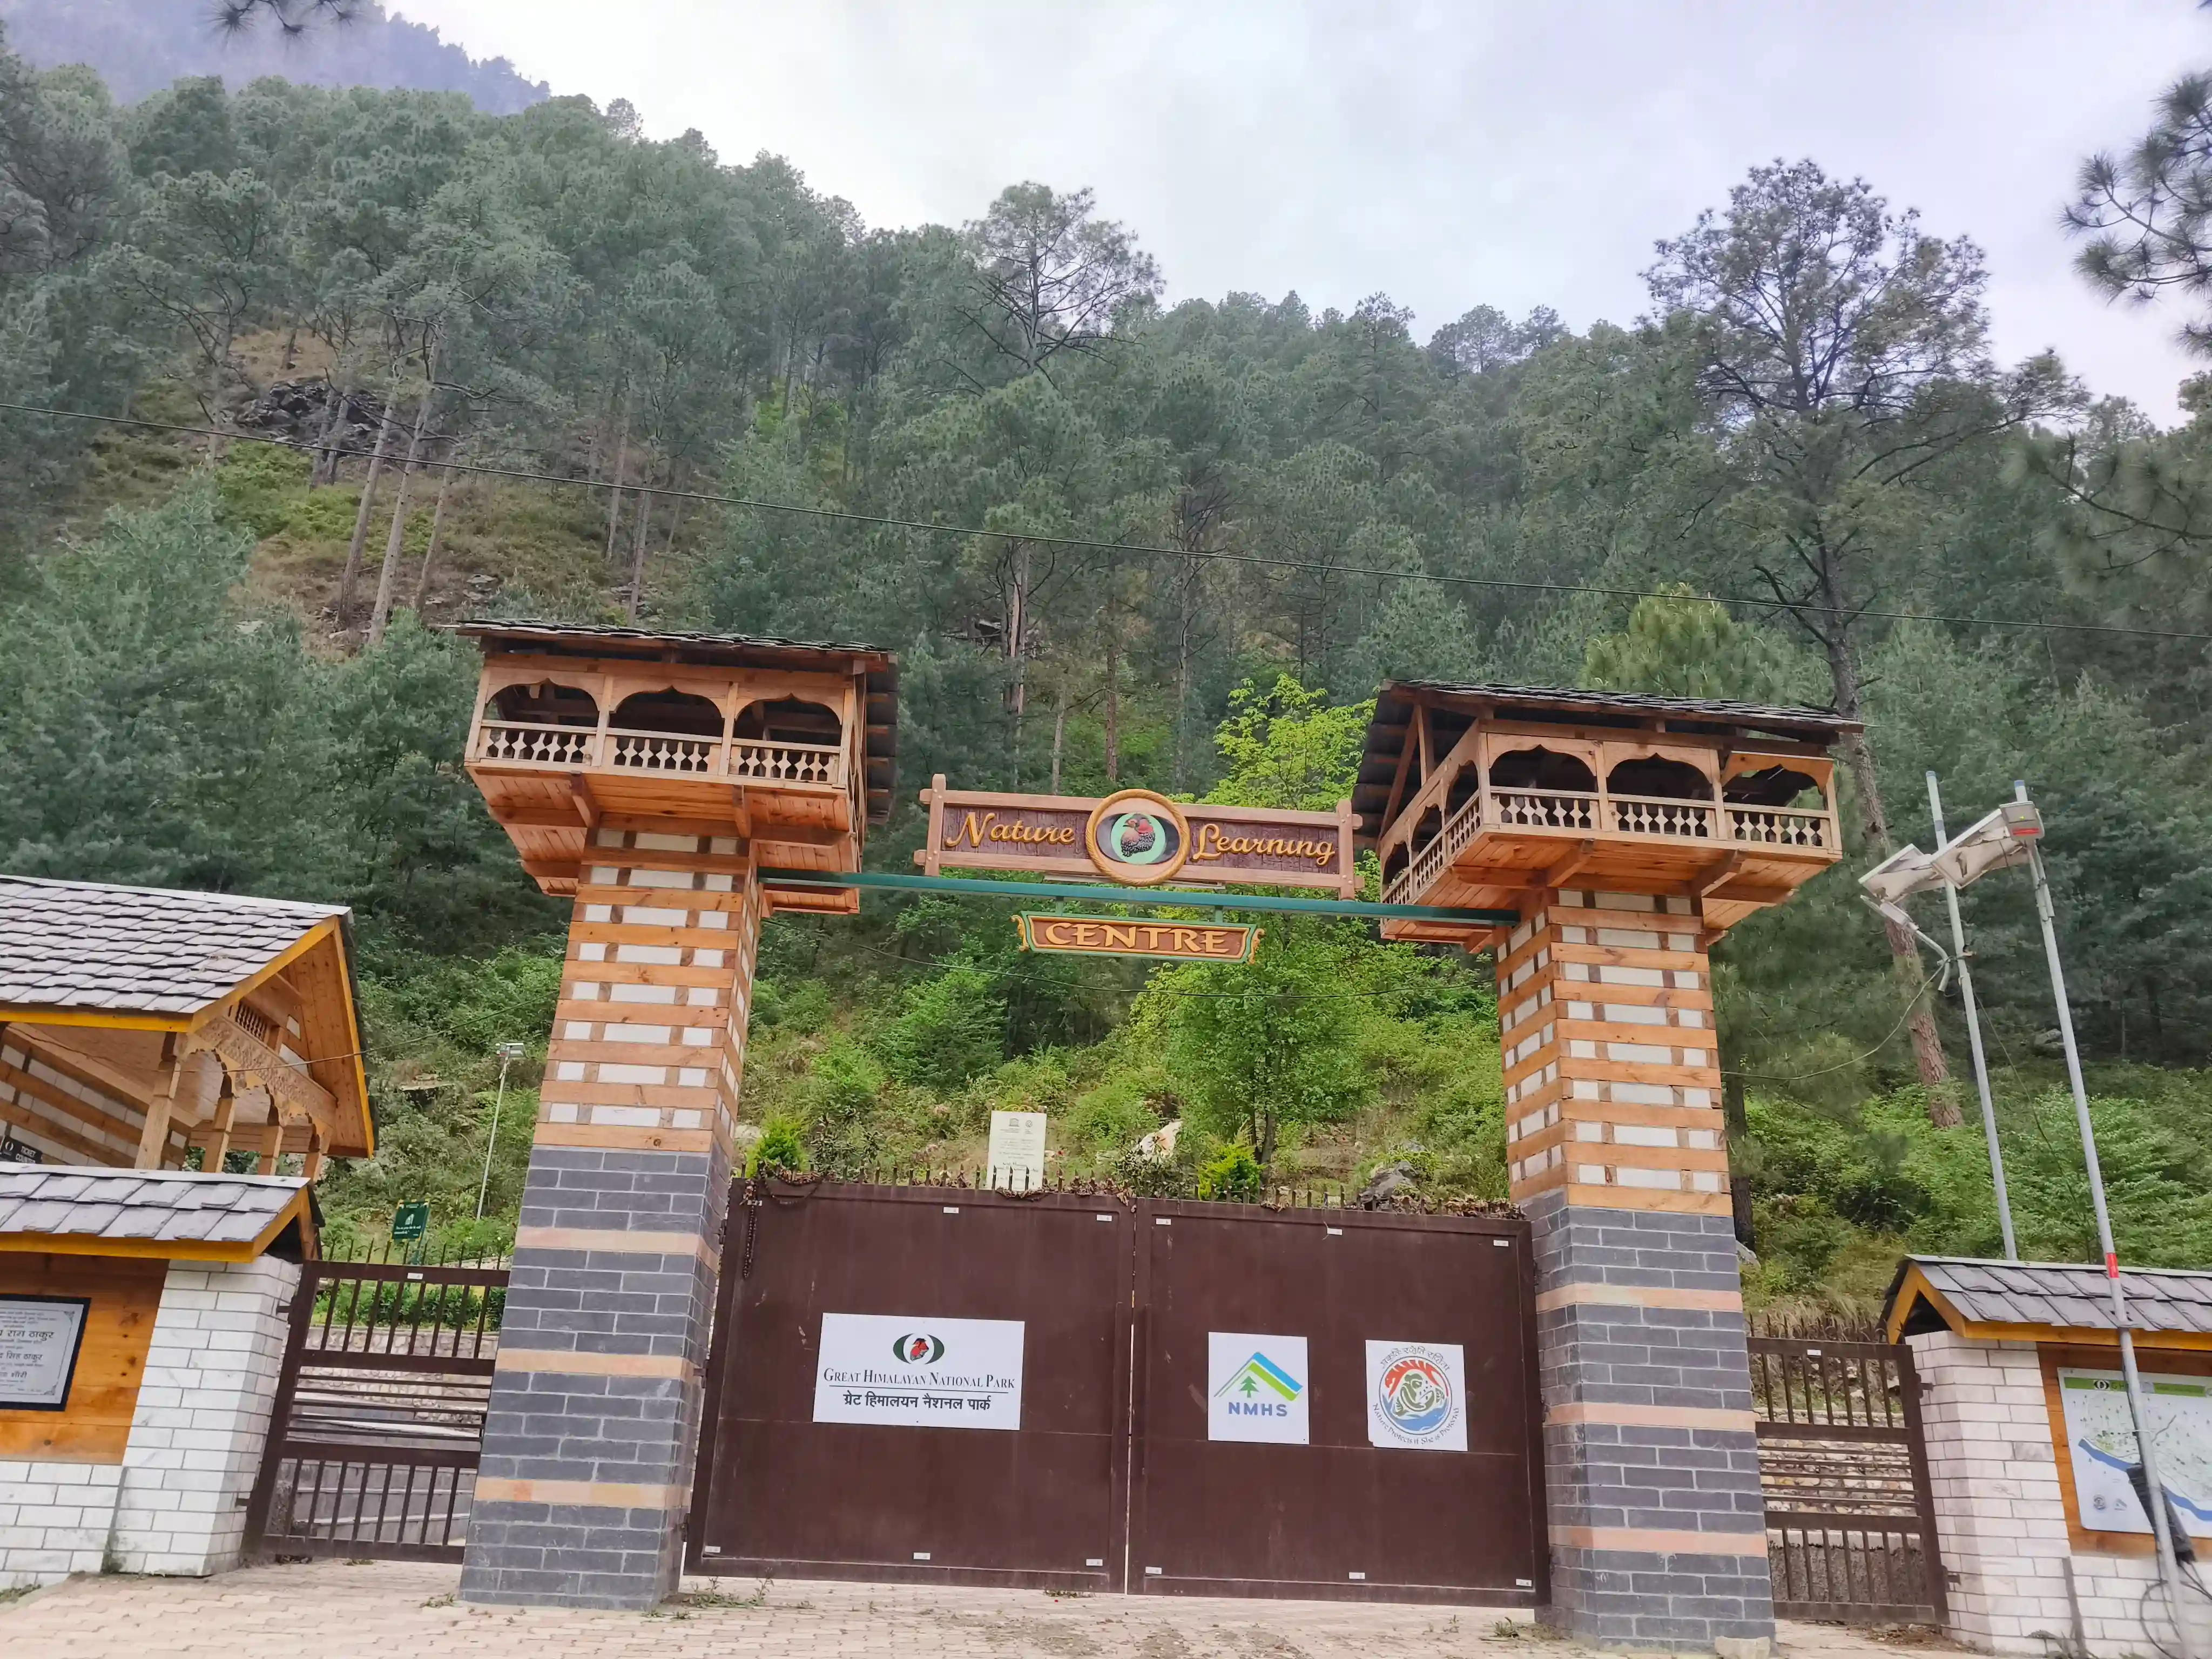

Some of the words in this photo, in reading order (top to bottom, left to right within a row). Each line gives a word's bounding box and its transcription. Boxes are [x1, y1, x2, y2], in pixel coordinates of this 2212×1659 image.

[945, 812, 1075, 847] Nature
[1190, 823, 1335, 867] Learning
[1046, 922, 1229, 954] CENTRE
[21, 1146, 36, 1157] TICKET
[29, 1331, 55, 1341] ठाकुर
[23, 1353, 43, 1363] ठाकुर
[824, 1367, 861, 1382] GREAT
[864, 1370, 927, 1385] HIMALAYAN
[929, 1372, 983, 1387] NATIONAL
[986, 1374, 1015, 1388] PARK
[843, 1390, 862, 1405] ग्रेट
[865, 1391, 919, 1407] हिमालयन
[922, 1393, 963, 1409] नैशनल
[967, 1395, 991, 1410] पार्क
[1229, 1402, 1287, 1417] NMHS
[1373, 1403, 1389, 1430] Nature
[1387, 1427, 1412, 1444] Protects
